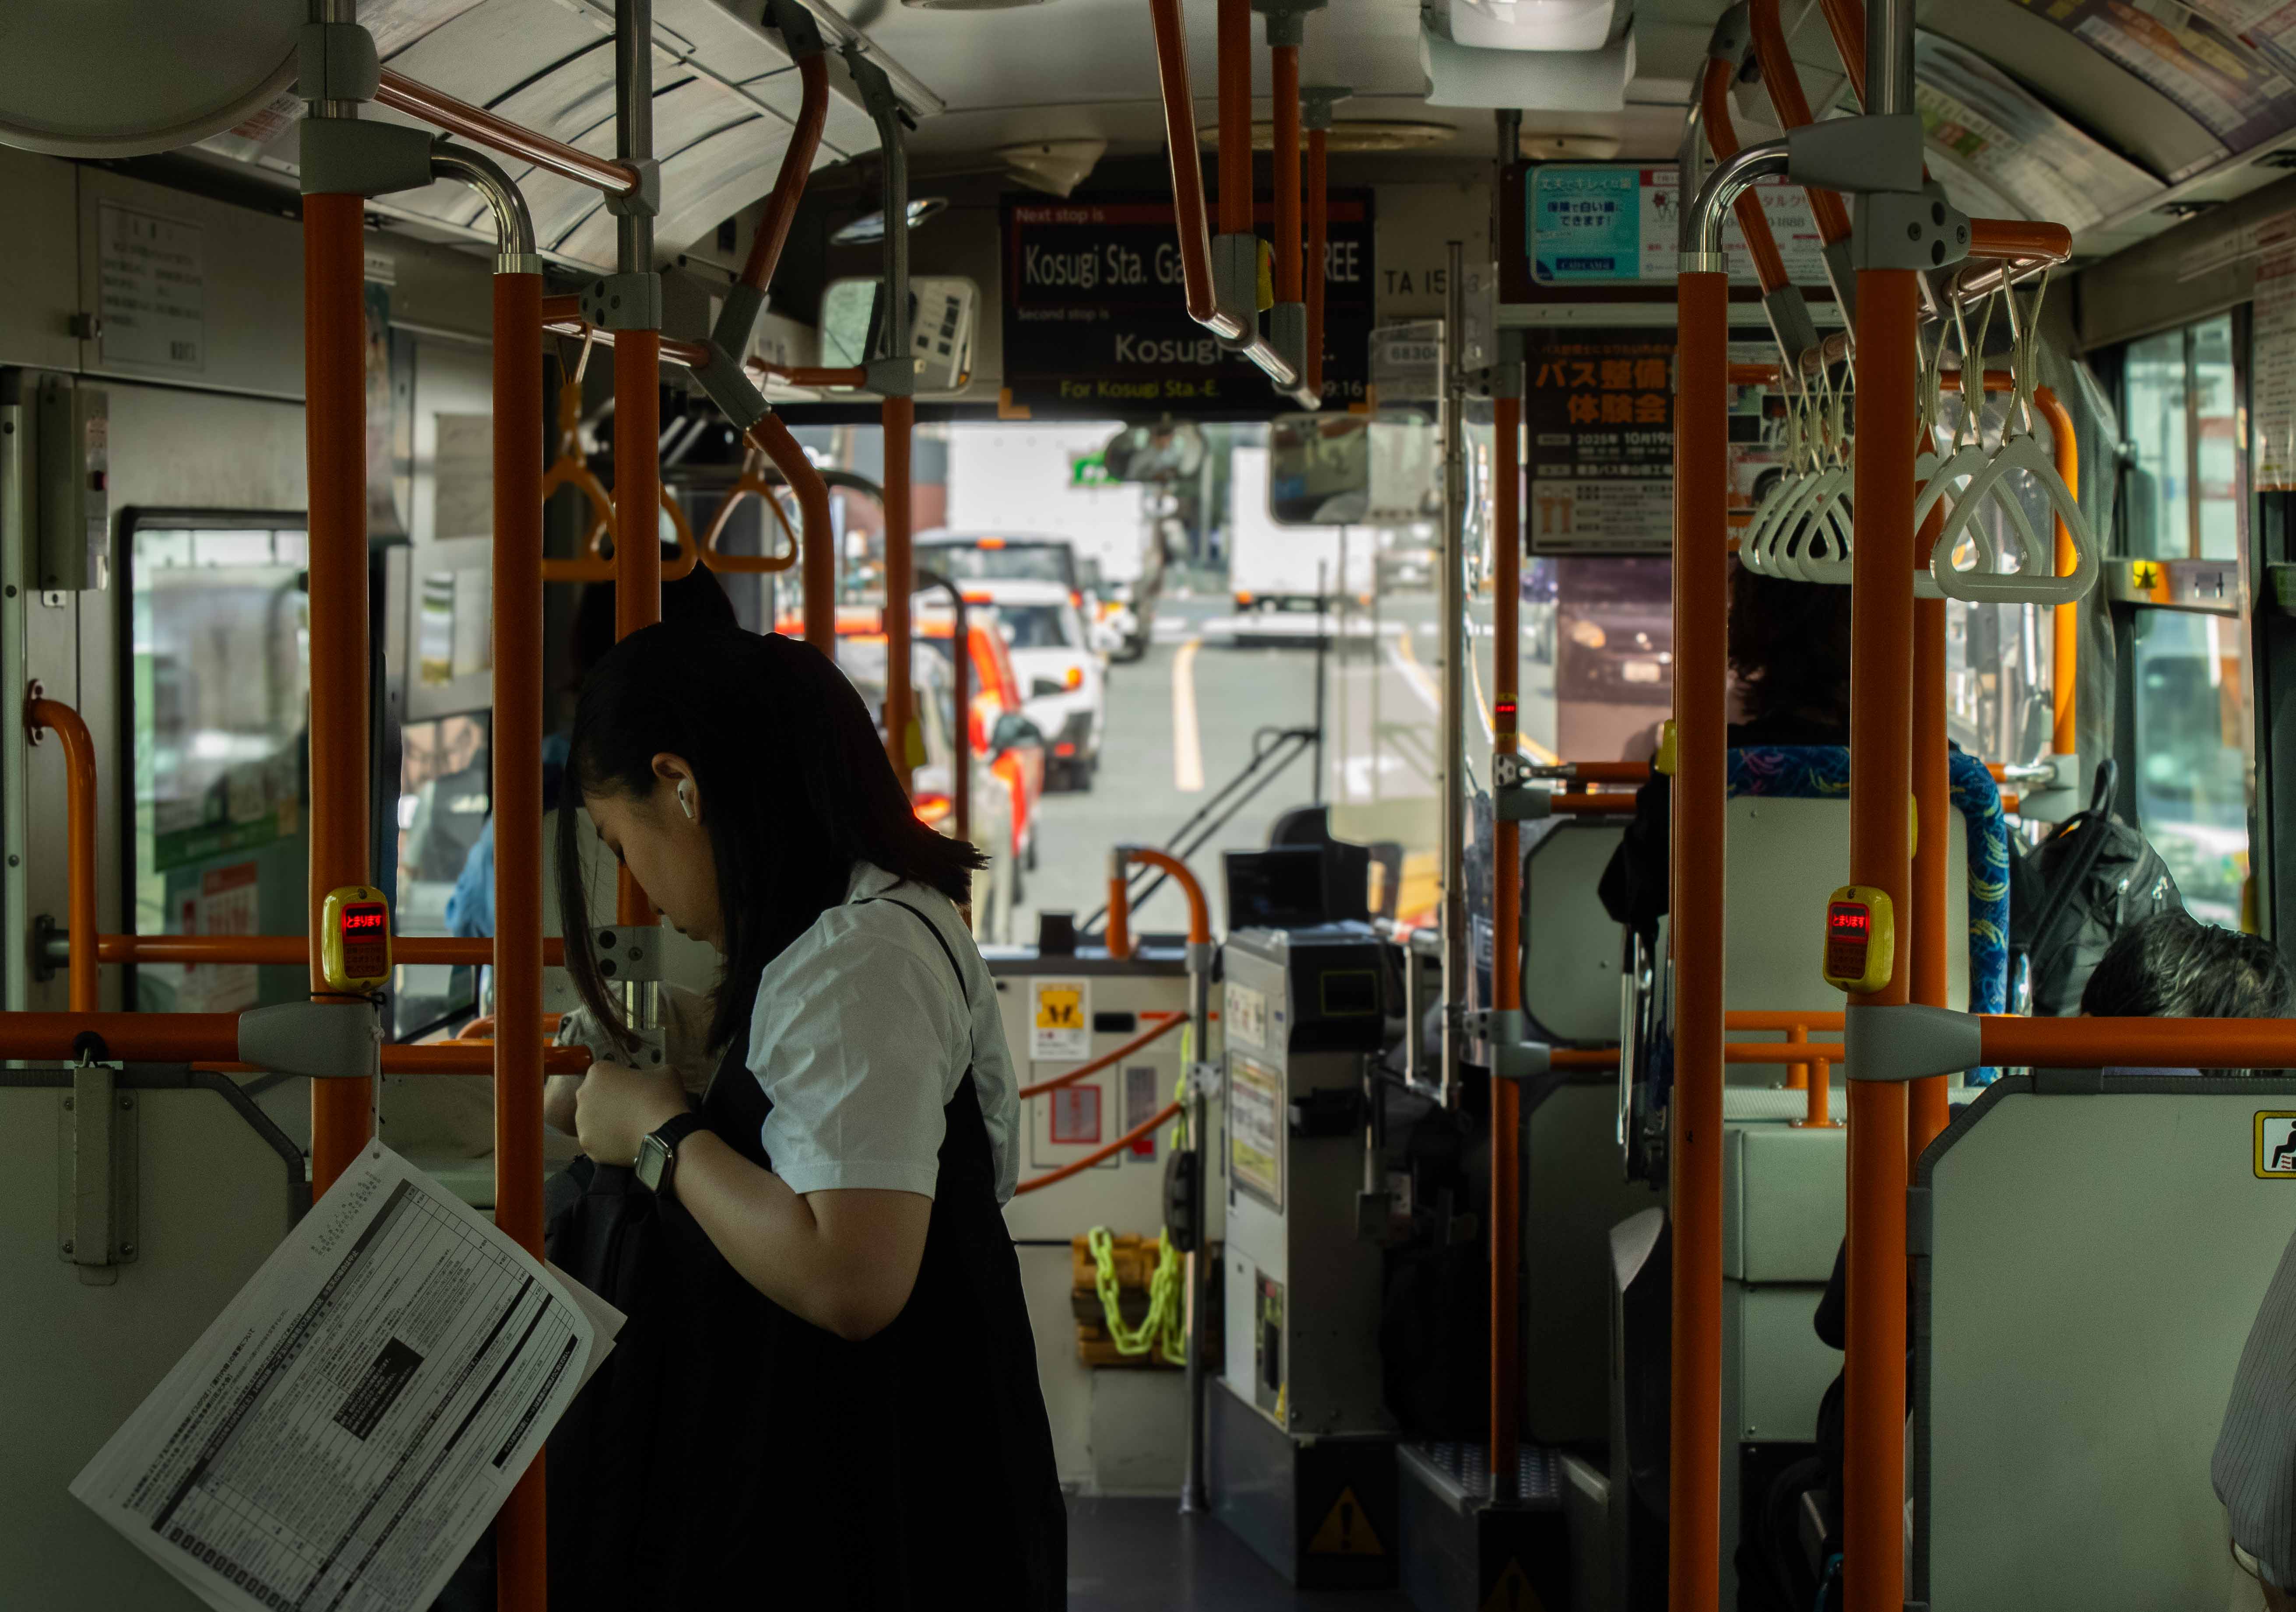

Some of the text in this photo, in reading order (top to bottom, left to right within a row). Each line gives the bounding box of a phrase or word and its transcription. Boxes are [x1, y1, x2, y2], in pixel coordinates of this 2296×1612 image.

[1016, 209, 1105, 224] Next stop is
[1025, 243, 1099, 289] Kosugi
[1106, 243, 1148, 285] Sta.
[1385, 269, 1413, 295] TA
[1018, 307, 1110, 324] Second stop is
[1115, 334, 1223, 366] Kosugi
[1535, 358, 1673, 389] バス整備
[1060, 380, 1092, 398] For
[1097, 380, 1160, 399] Kosugi
[1322, 380, 1364, 398] 9:16
[1568, 393, 1667, 425] 体験会
[346, 914, 382, 929] とまります
[1832, 914, 1865, 928] とまります
